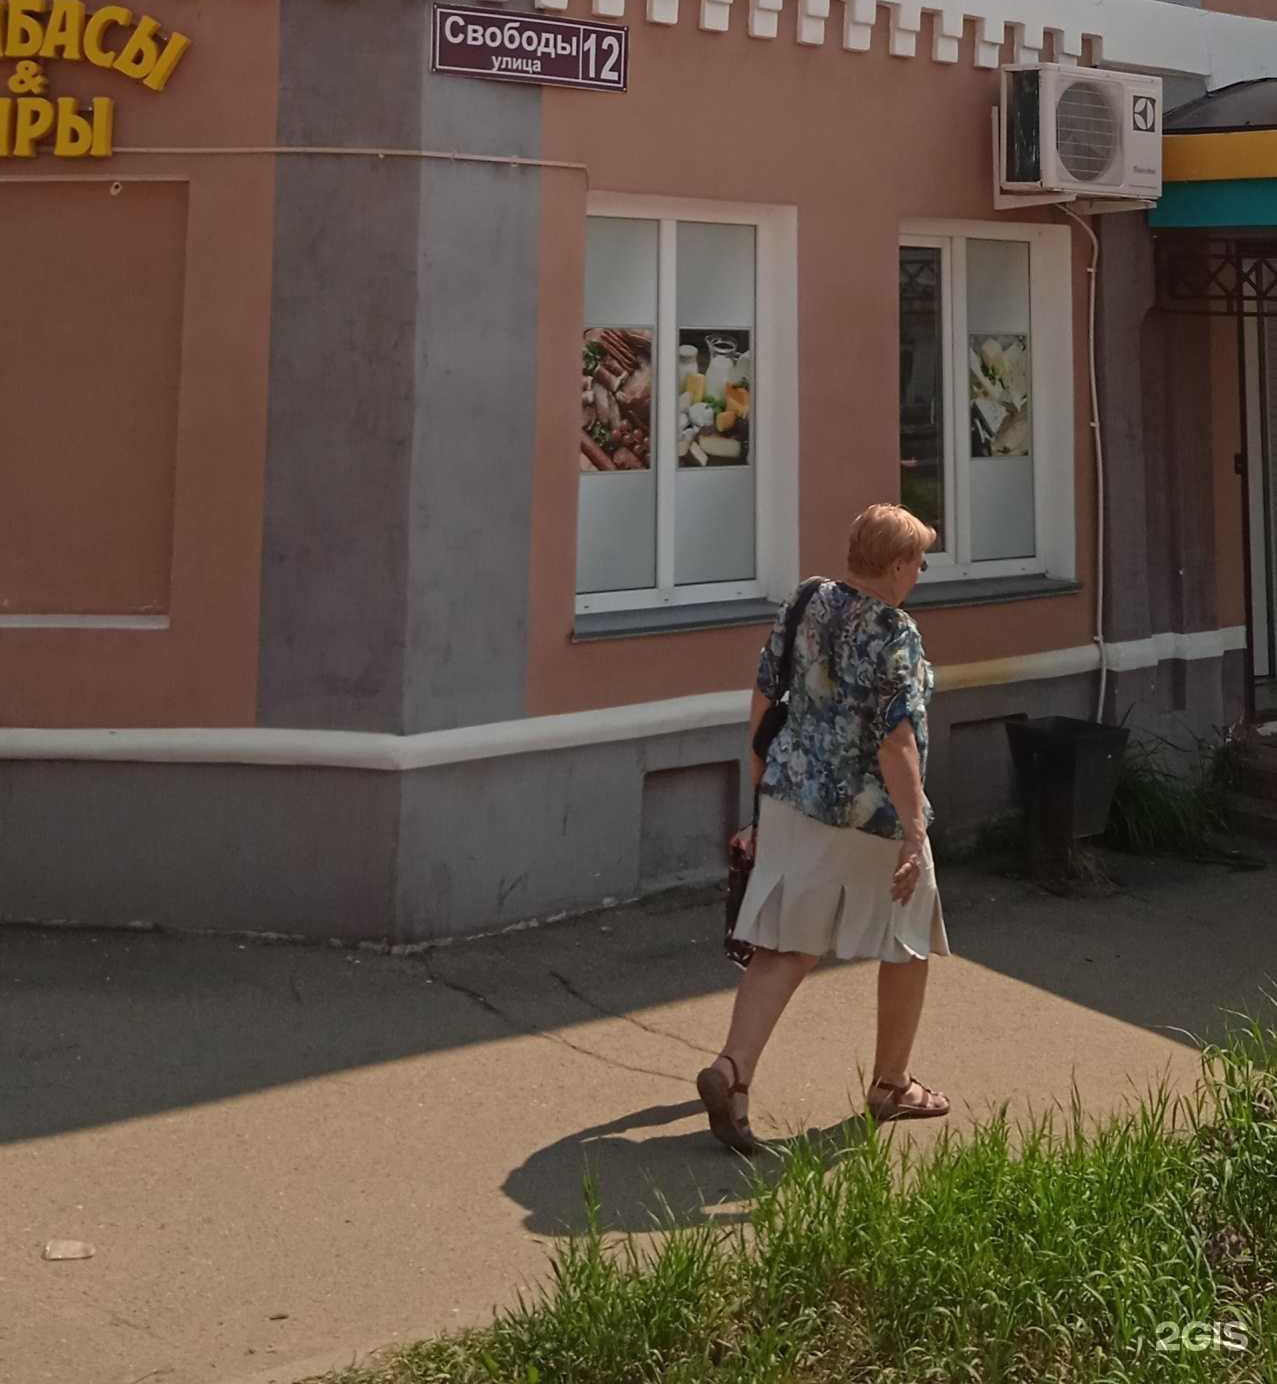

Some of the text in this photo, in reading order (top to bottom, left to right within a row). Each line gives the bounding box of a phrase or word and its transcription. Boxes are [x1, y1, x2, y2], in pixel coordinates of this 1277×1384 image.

[444, 15, 577, 58] Свободы
[583, 33, 620, 81] 12
[8, 59, 47, 95] &
[491, 54, 542, 73] улица
[0, 96, 113, 157] РЫ
